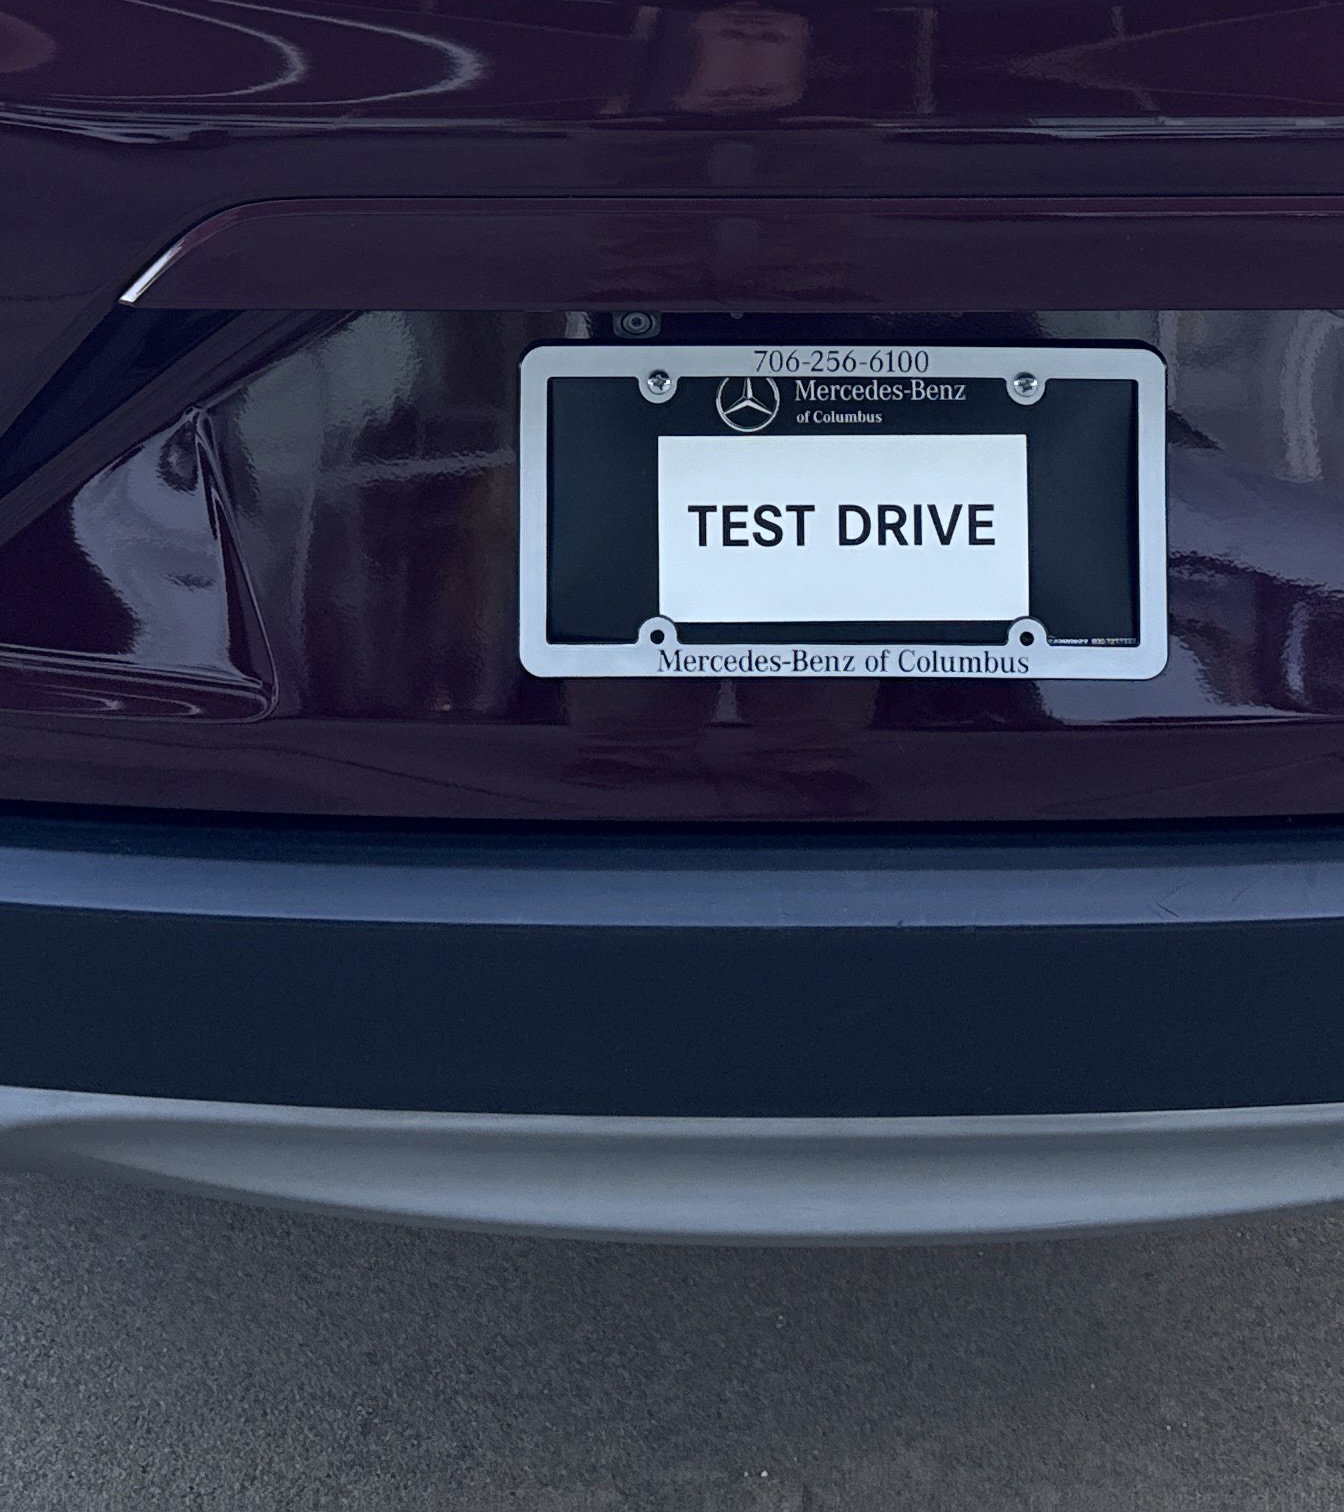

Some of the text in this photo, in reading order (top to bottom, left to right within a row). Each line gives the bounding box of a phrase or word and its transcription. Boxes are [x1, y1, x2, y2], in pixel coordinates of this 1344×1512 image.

[753, 349, 930, 373] 706-256-6100
[794, 379, 967, 401] Mercedes-Benz
[796, 410, 883, 424] of Columbus
[687, 503, 996, 548] TEST DRIVE
[656, 648, 1030, 674] Mercedes-Benz of Columbus
